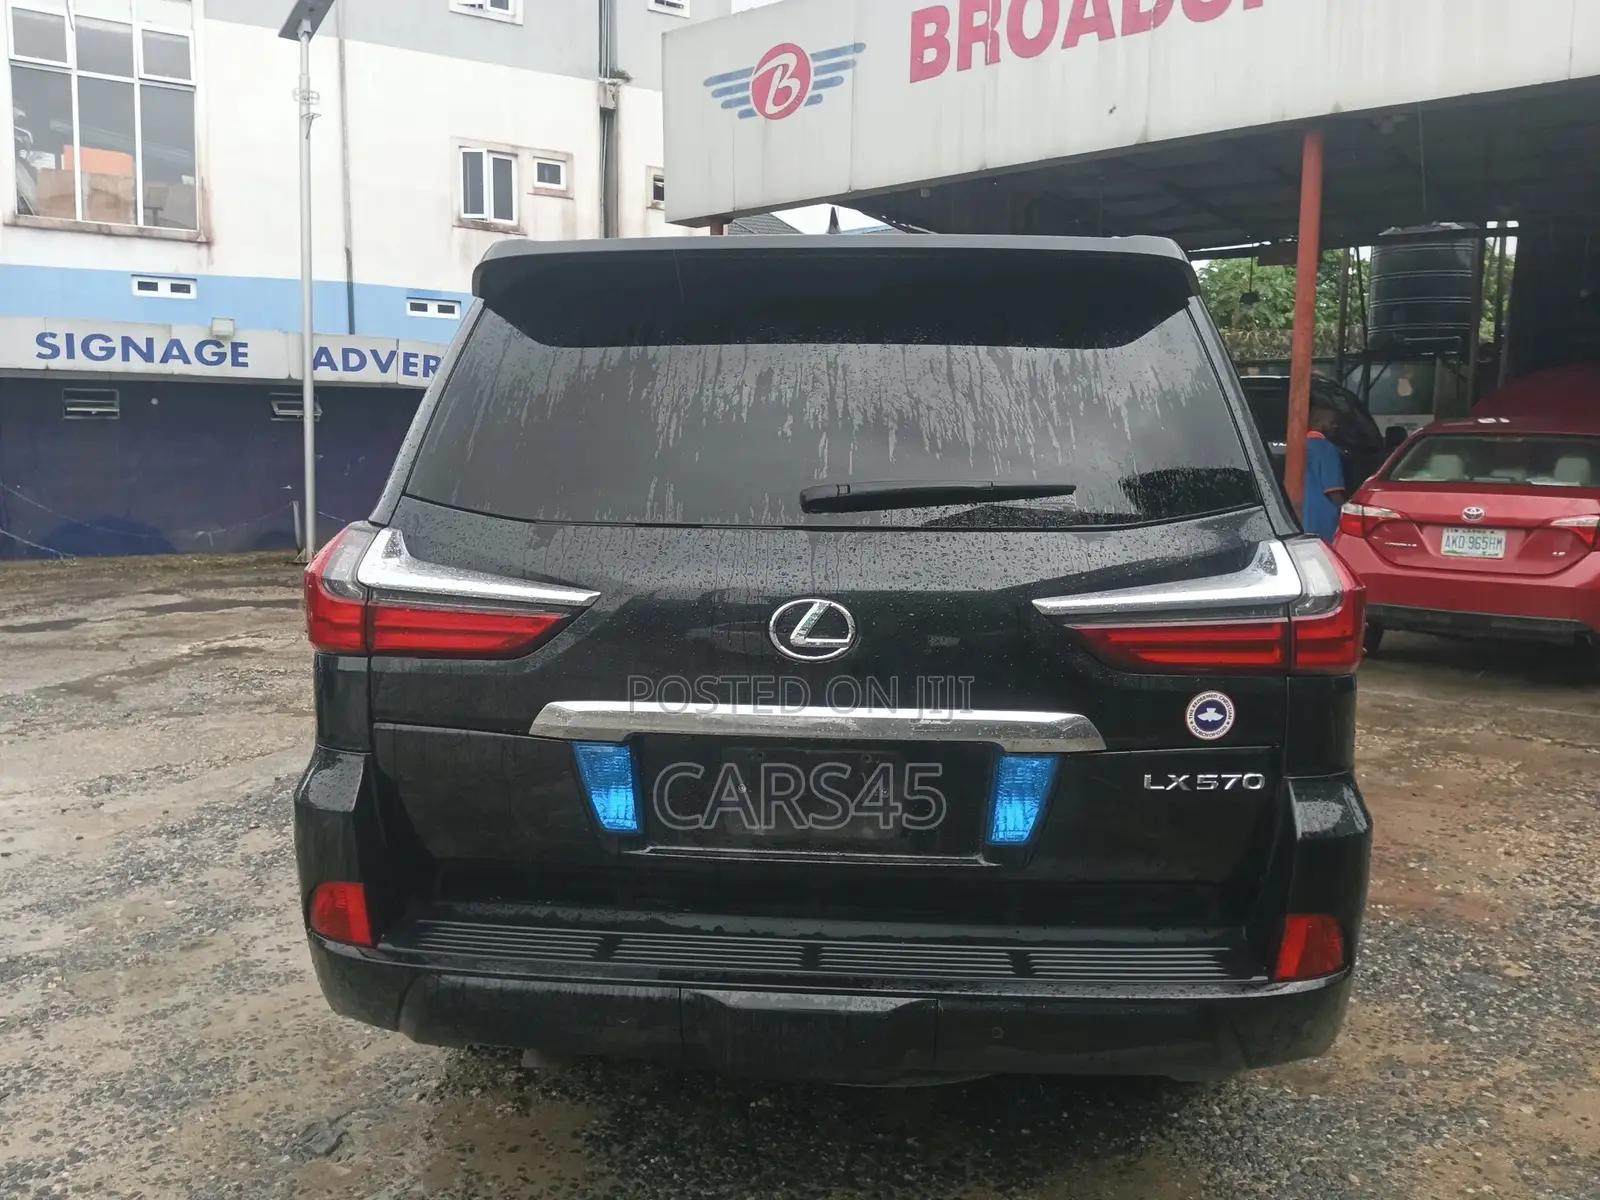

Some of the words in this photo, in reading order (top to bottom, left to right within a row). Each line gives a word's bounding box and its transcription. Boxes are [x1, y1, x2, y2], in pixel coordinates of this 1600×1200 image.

[909, 0, 1263, 83] BROAD
[35, 331, 249, 368] SIGNAGE
[1143, 774, 1192, 791] LX
[1196, 773, 1266, 791] 570
